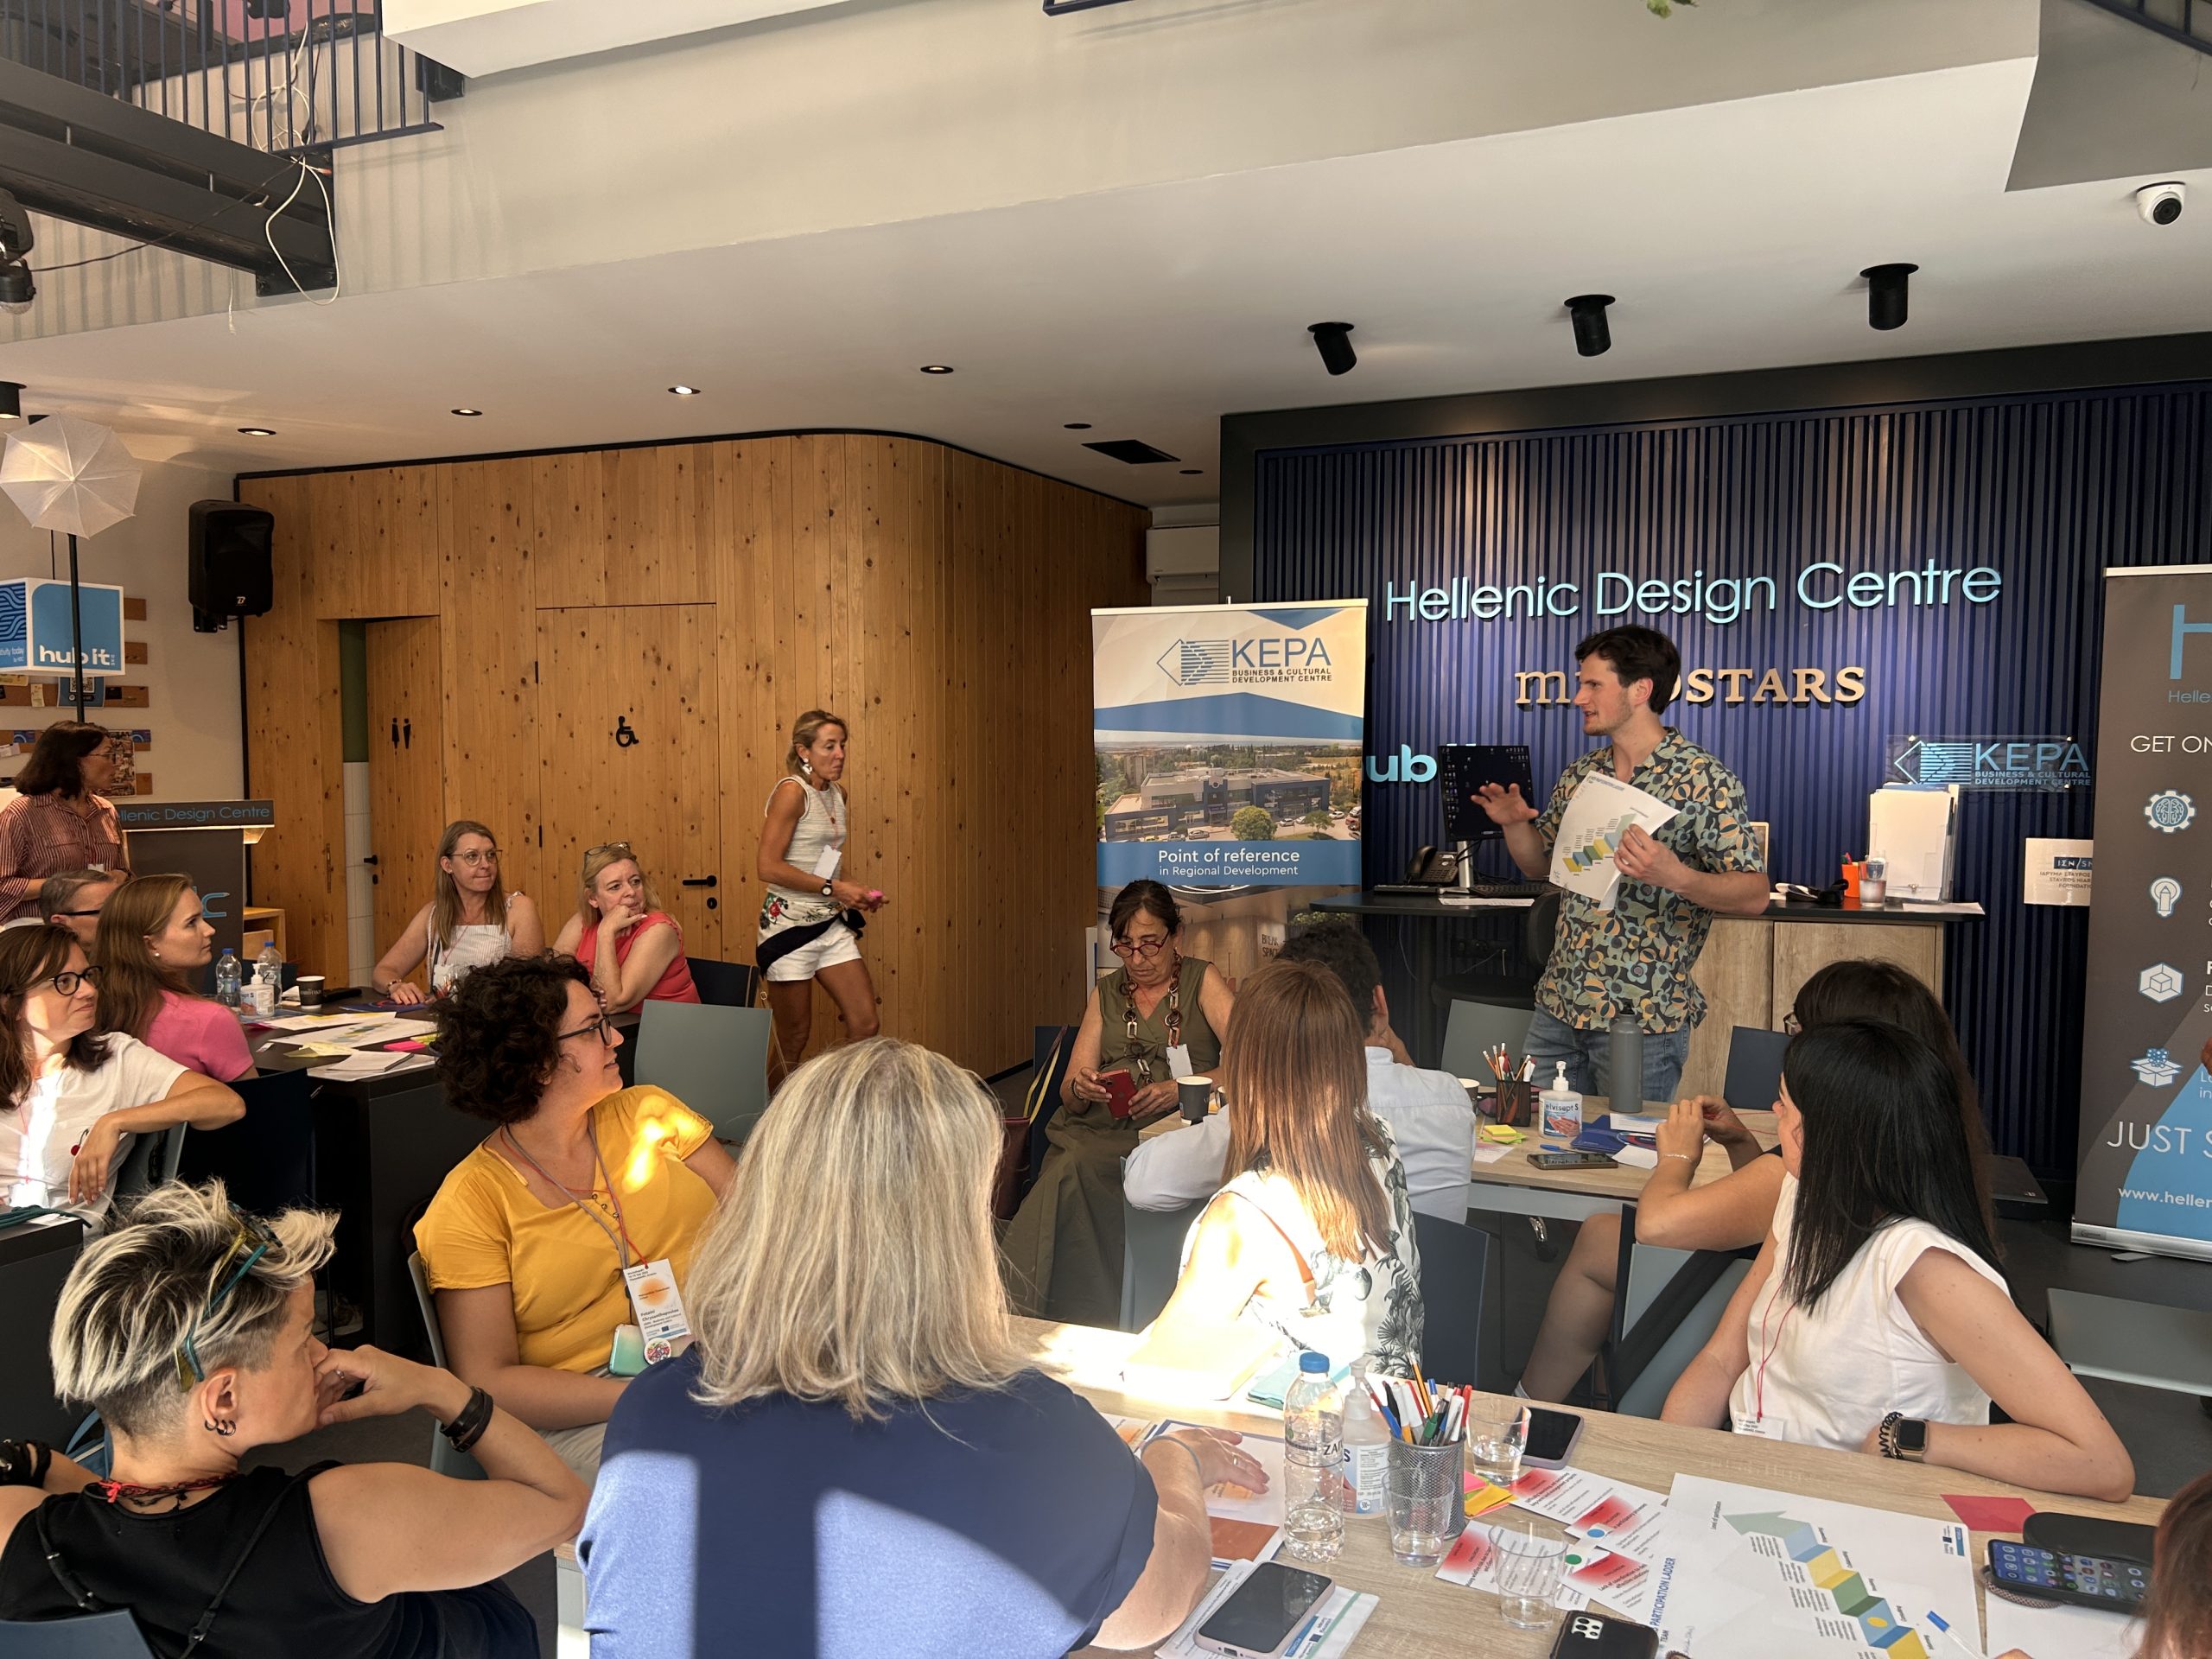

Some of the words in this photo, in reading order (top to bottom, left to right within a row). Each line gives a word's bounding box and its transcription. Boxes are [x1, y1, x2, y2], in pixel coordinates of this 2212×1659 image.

[1386, 575, 1580, 621] Hellenic
[1596, 570, 1776, 624] Design
[1797, 558, 2002, 608] Centre
[1231, 638, 1332, 668] KEPA
[1515, 667, 1866, 704] mSTARS
[2130, 734, 2176, 753] GET
[1974, 742, 2089, 772] KEPA
[164, 808, 216, 823] Design
[219, 806, 270, 819] Centre
[1158, 849, 1198, 863] Point
[1204, 849, 1220, 862] of
[1224, 849, 1300, 862] reference
[1159, 867, 1169, 875] in
[1173, 866, 1220, 878] Regional
[1224, 865, 1299, 877] Development
[1574, 1103, 1579, 1111] S
[2107, 1121, 2192, 1155] JUST
[1344, 1448, 1351, 1463] S
[1649, 1580, 1669, 1626] PARTICIPATION
[1662, 1557, 1675, 1580] LADDER
[1660, 1630, 1669, 1643] TEAM
